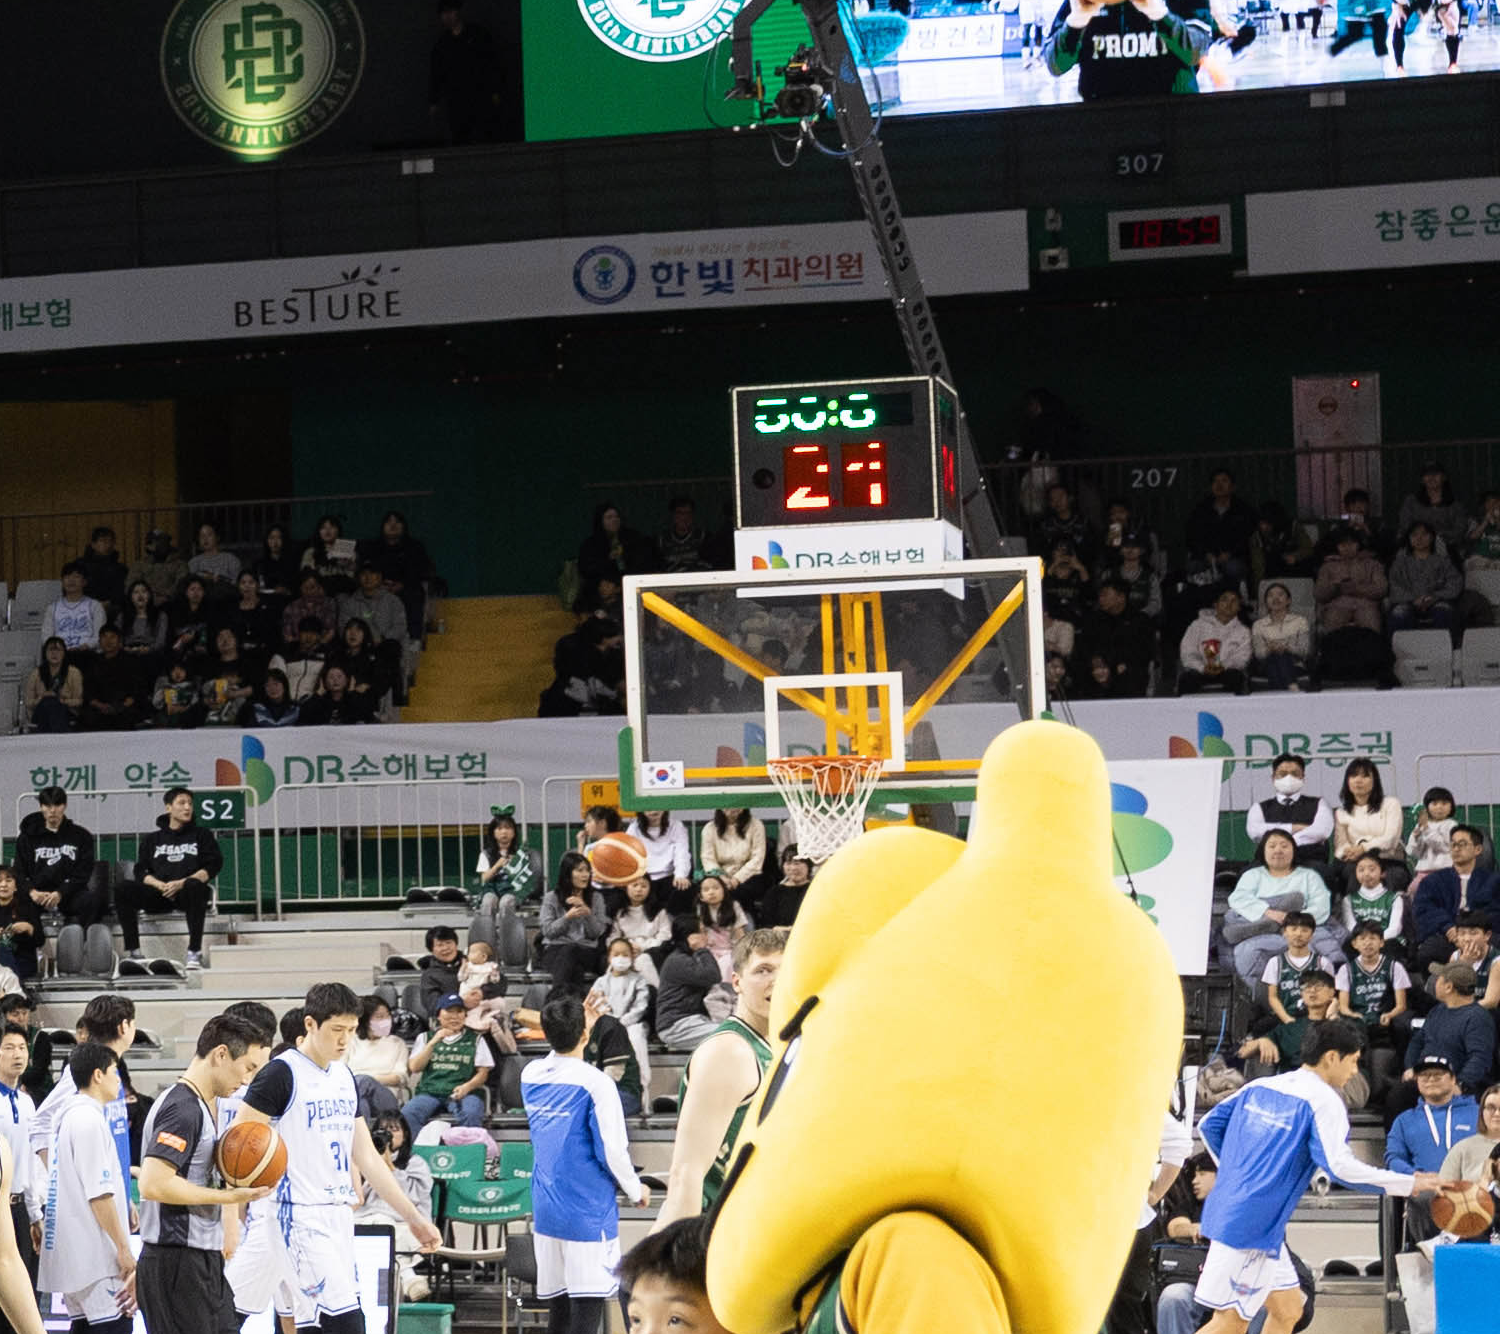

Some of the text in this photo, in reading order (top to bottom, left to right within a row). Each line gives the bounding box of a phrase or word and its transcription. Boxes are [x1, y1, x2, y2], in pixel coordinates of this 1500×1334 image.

[1116, 154, 1164, 176] 307
[1131, 214, 1220, 249] 18:59
[649, 250, 865, 300] 한빛 치과의원
[233, 284, 403, 329] BESTURE
[1129, 468, 1179, 489] 207
[1243, 728, 1396, 773] DB증권
